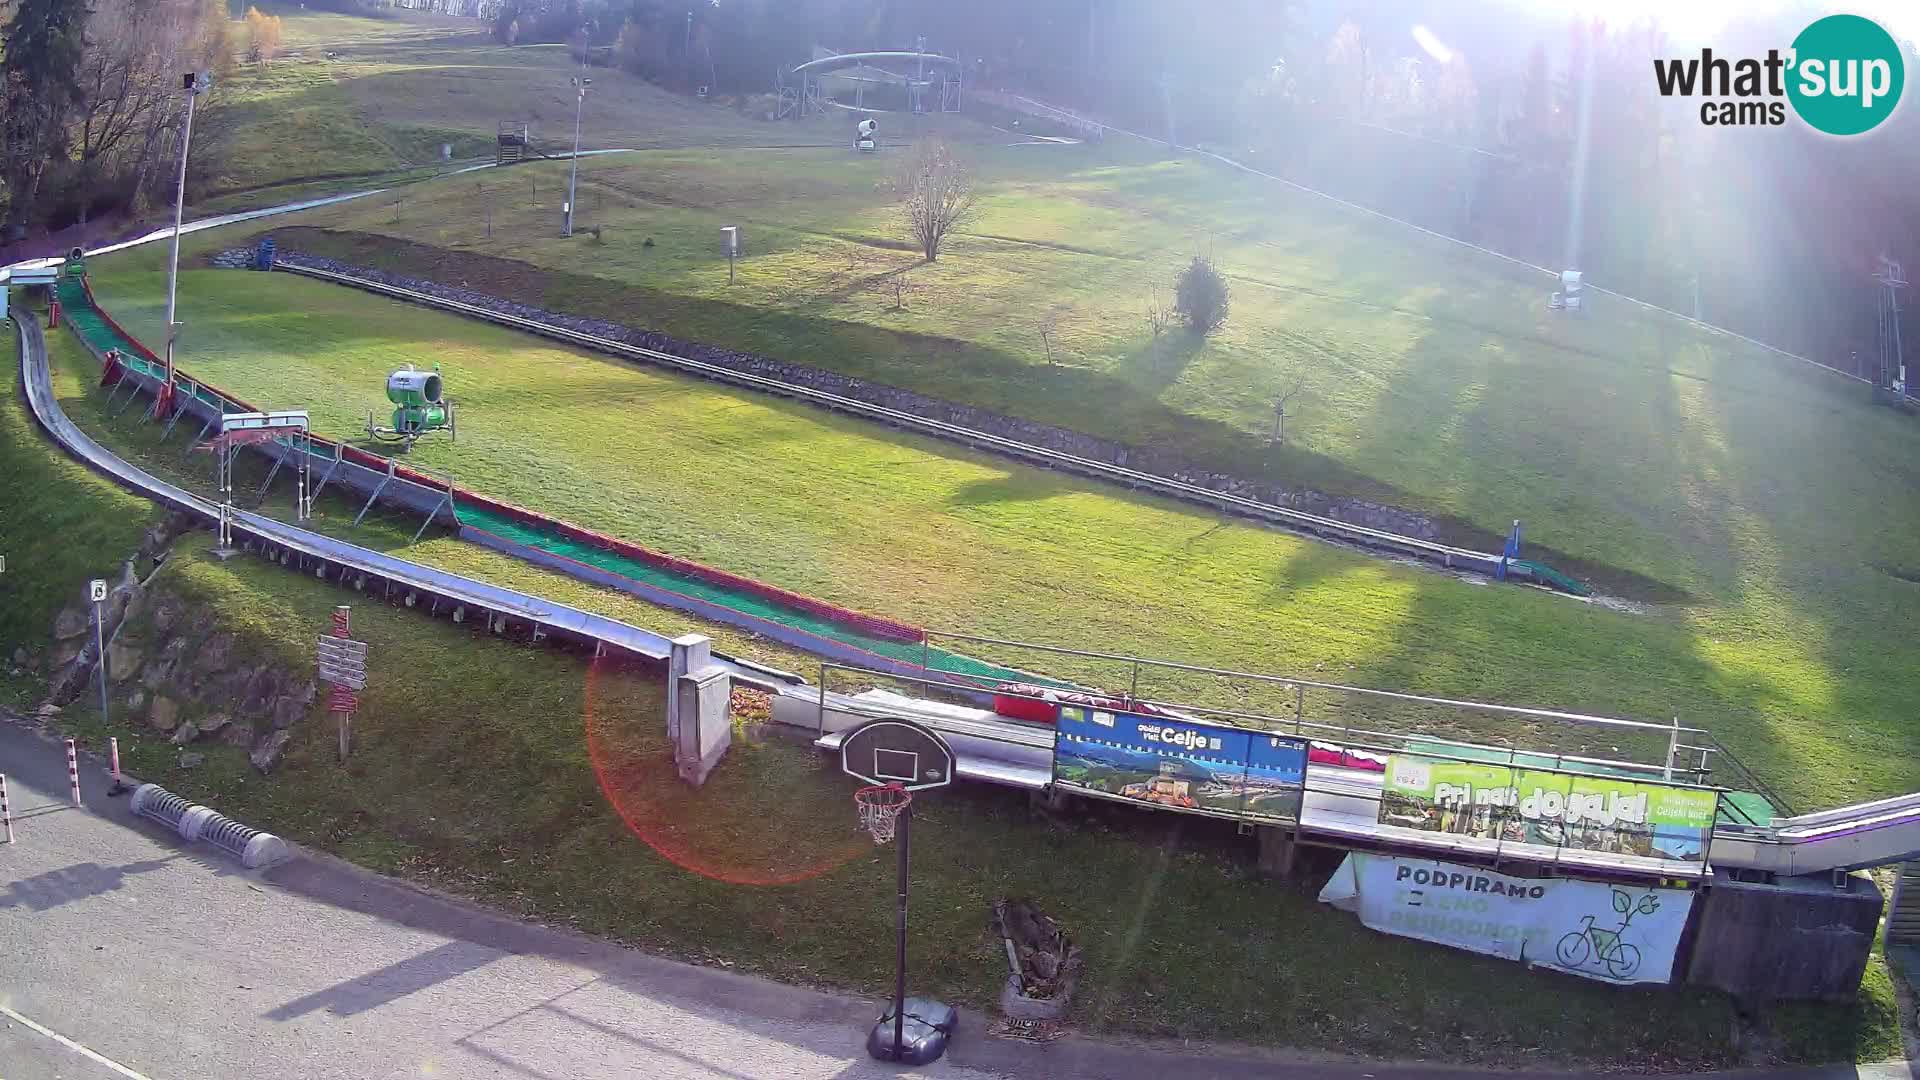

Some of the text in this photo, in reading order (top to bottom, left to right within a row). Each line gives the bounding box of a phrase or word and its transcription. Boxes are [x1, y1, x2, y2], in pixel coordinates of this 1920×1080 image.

[1161, 728, 1207, 750] Celje
[1434, 782, 1472, 805] Pri
[1396, 865, 1545, 898] PODPIRAMO
